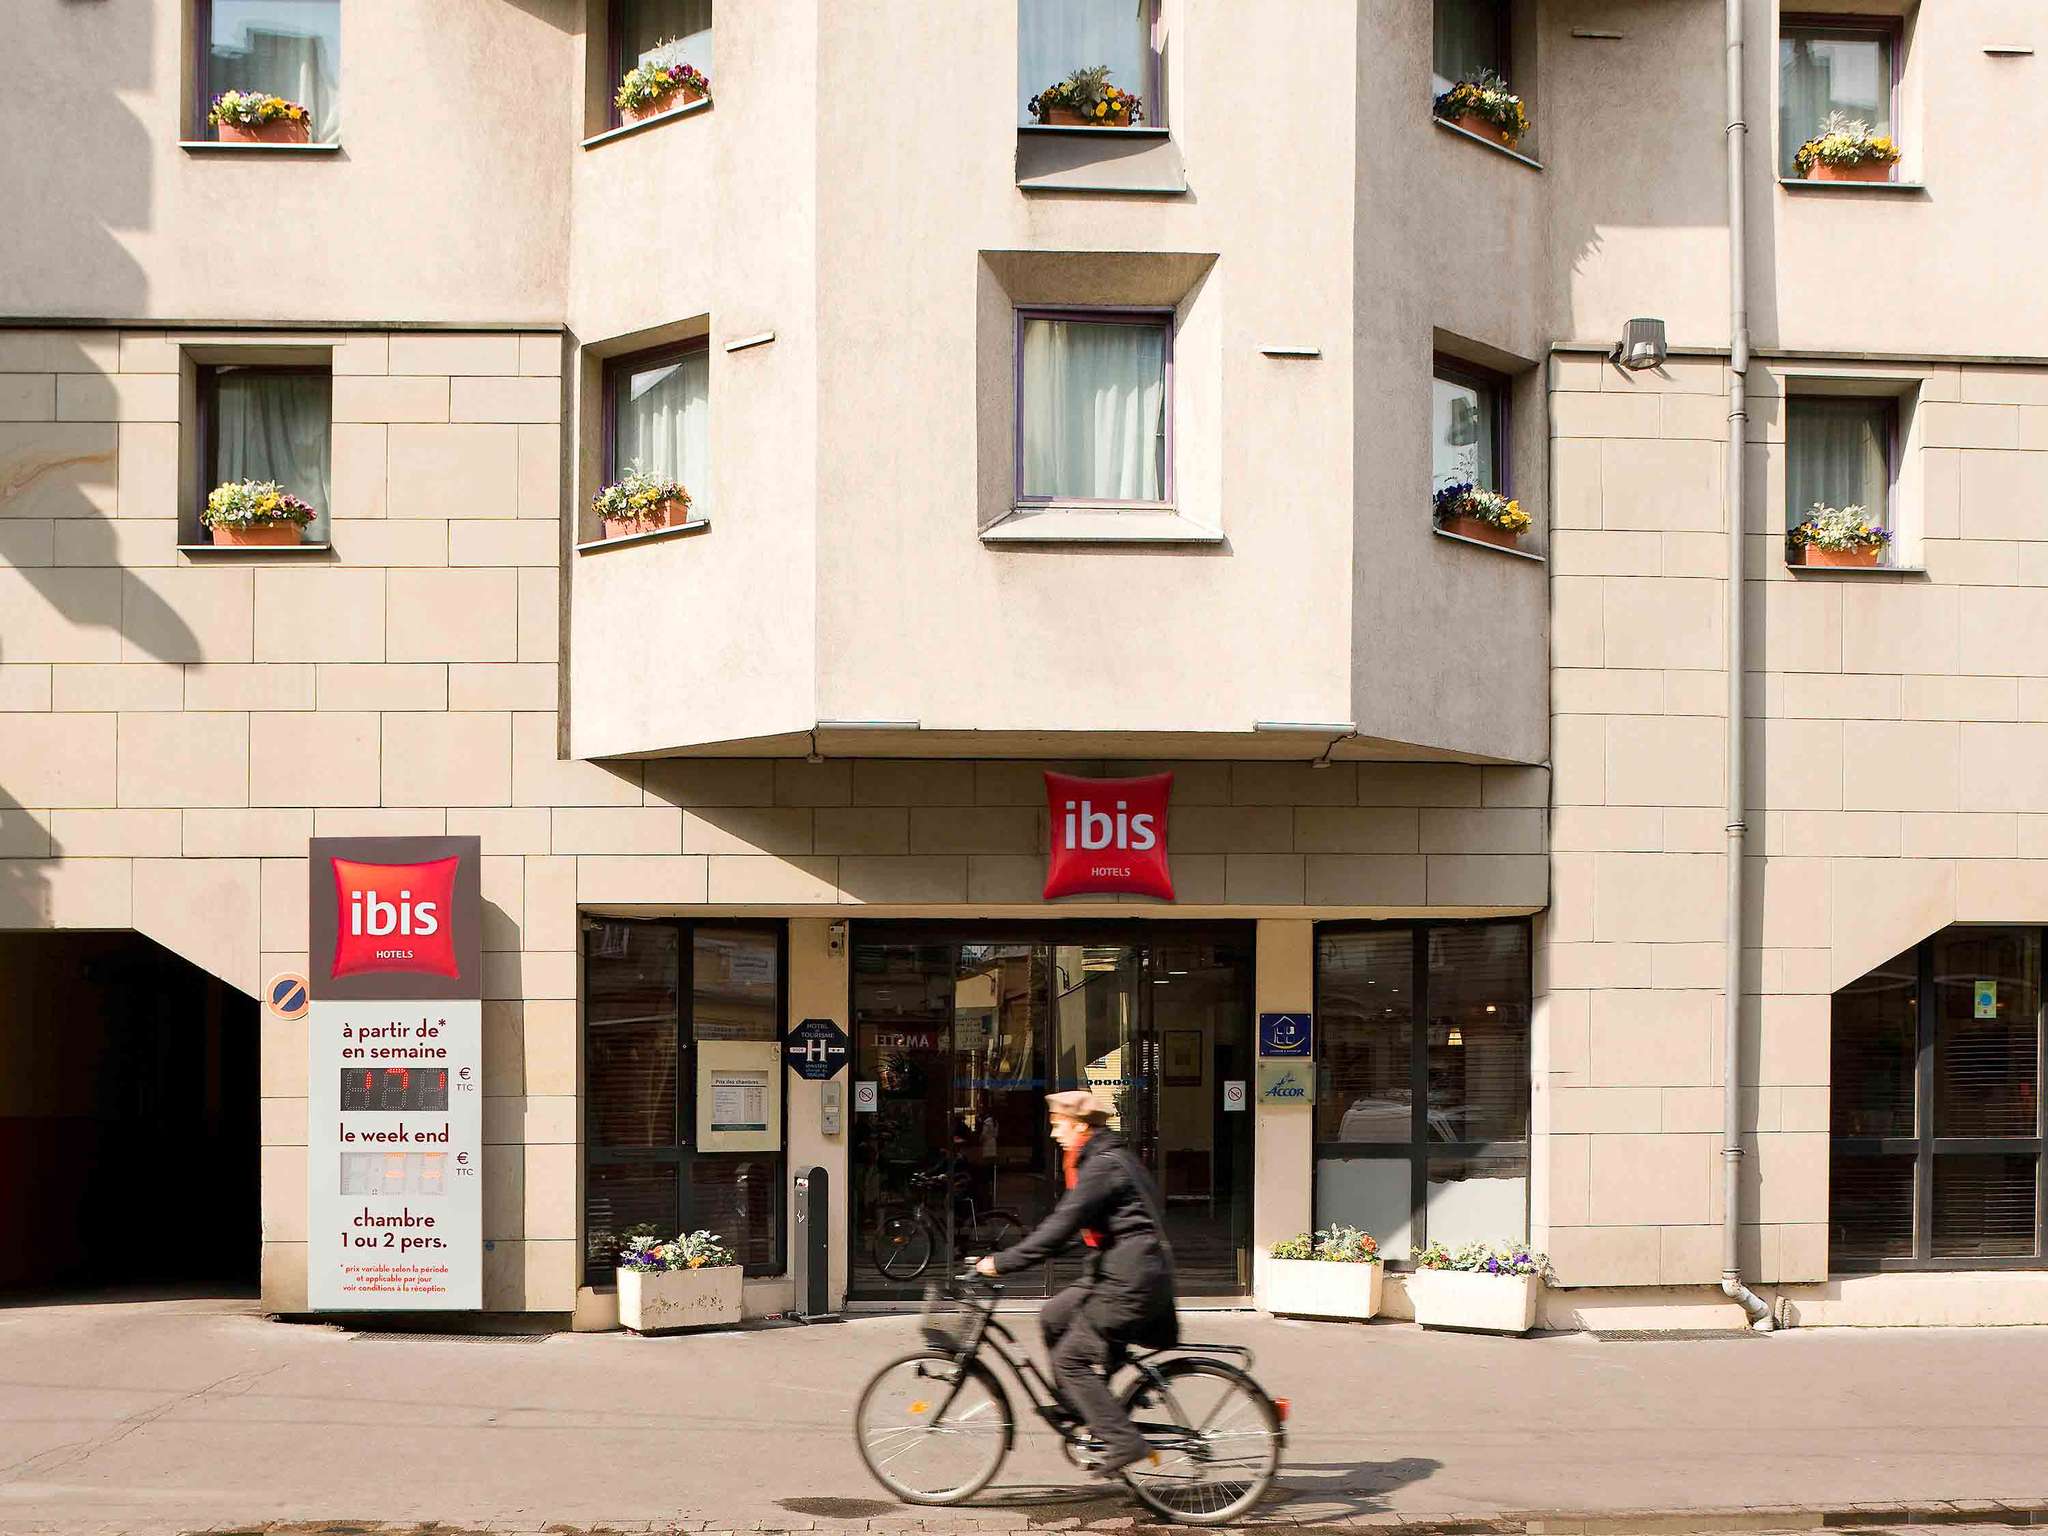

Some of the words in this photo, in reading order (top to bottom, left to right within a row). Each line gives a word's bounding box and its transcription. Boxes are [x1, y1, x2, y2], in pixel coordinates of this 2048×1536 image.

[1065, 800, 1156, 850] ibis
[1091, 867, 1131, 877] HOTELS
[351, 890, 438, 936] ibis
[376, 950, 414, 959] HOTELS
[342, 1023, 352, 1037] à
[359, 1022, 410, 1043] partir
[342, 1047, 364, 1058] en
[370, 1043, 447, 1058] semaine
[807, 1040, 827, 1062] H
[459, 1067, 471, 1080] €
[456, 1084, 473, 1092] TTC
[340, 1123, 355, 1142] le
[361, 1123, 408, 1142] week
[415, 1123, 449, 1142] end
[457, 1152, 469, 1165] €
[456, 1168, 474, 1176] TTC
[353, 1207, 435, 1227] chambre
[341, 1232, 348, 1247] 1
[355, 1237, 377, 1248] ou
[383, 1232, 395, 1247] 2
[401, 1237, 447, 1253] pers.
[345, 1265, 360, 1274] prix
[362, 1264, 390, 1273] variable
[392, 1264, 411, 1273] selon
[412, 1264, 419, 1273] la
[365, 1275, 402, 1283] applicable
[417, 1275, 432, 1284] jour
[343, 1284, 356, 1292] voir
[358, 1284, 395, 1292] conditions
